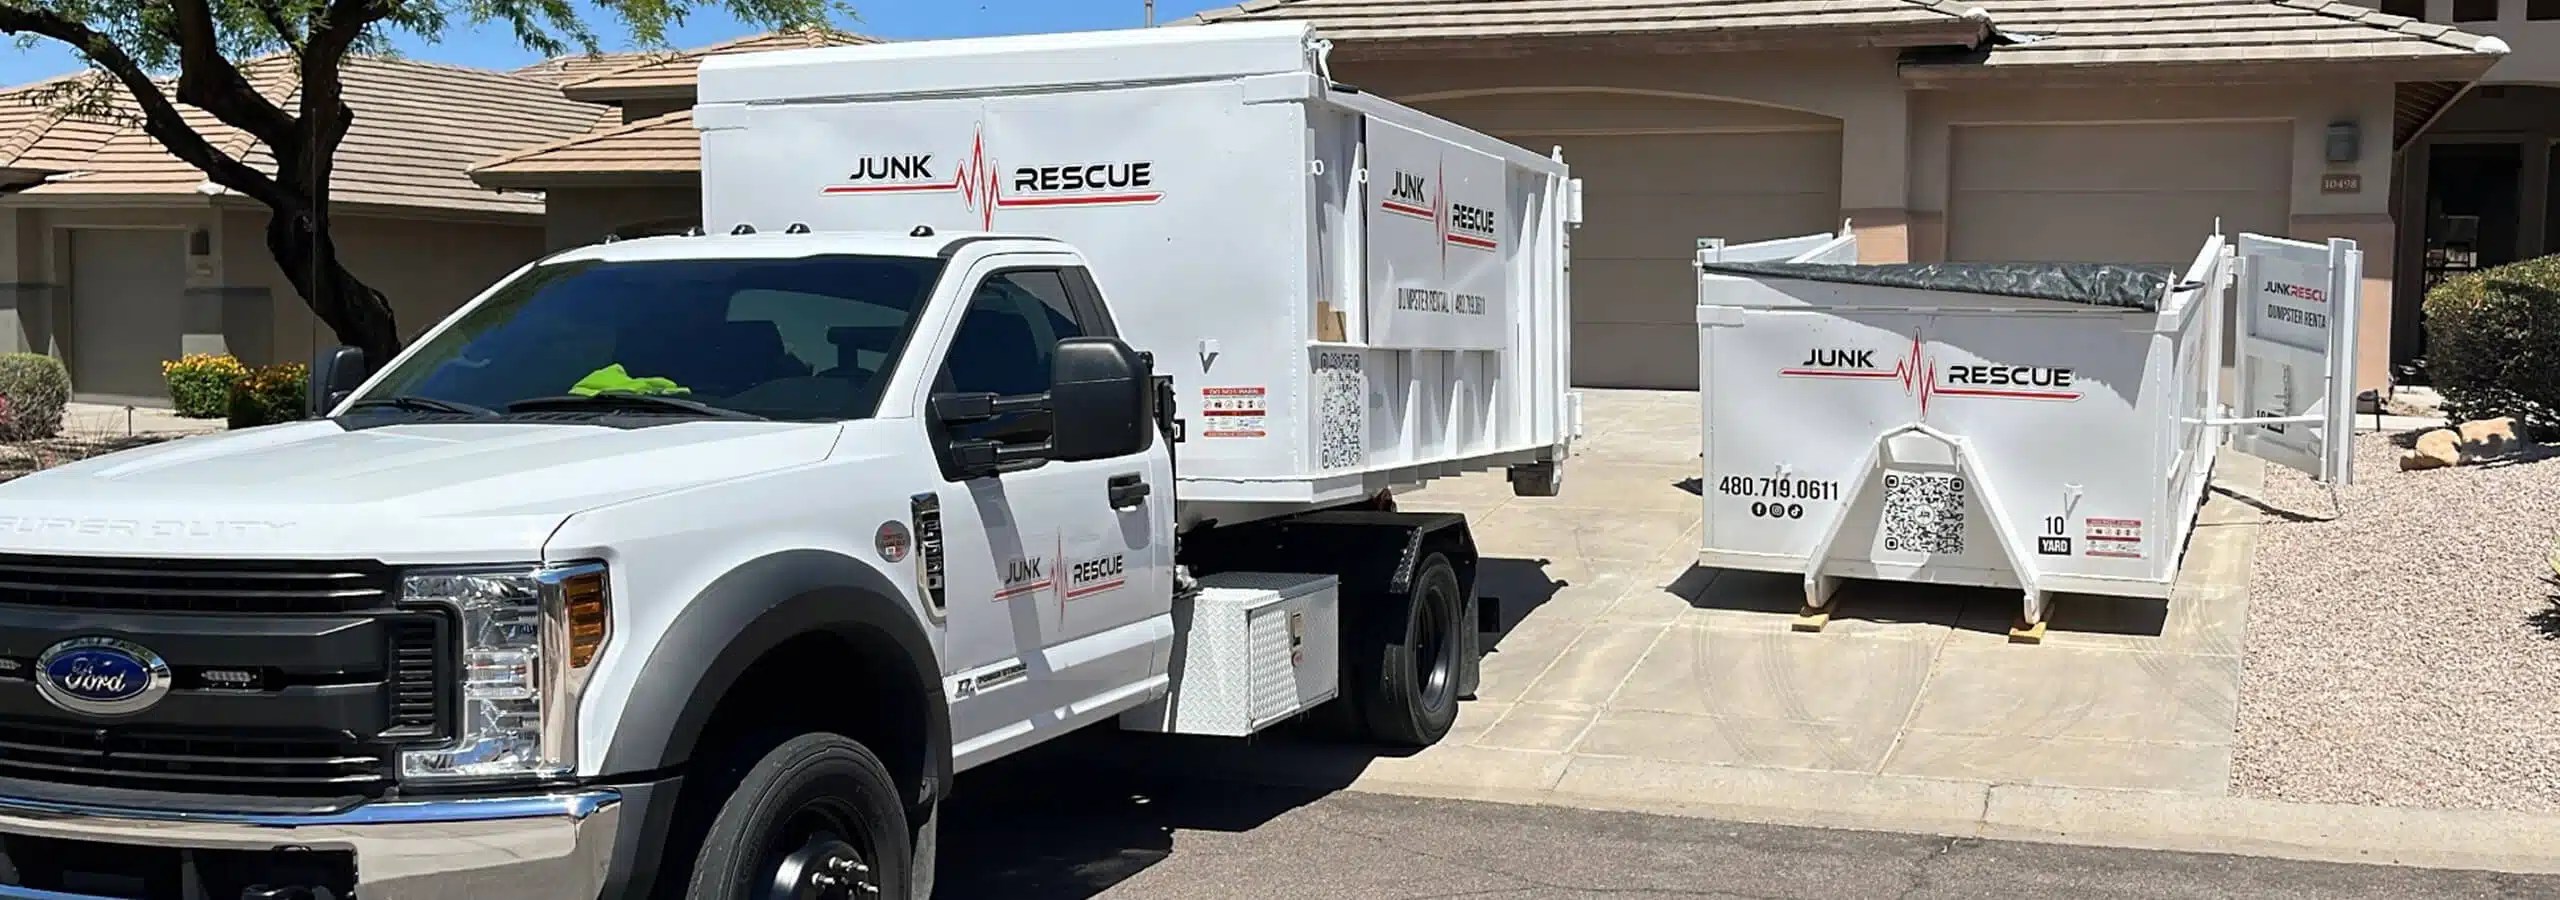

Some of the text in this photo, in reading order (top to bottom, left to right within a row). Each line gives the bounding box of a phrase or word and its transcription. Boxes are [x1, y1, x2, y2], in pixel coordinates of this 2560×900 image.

[850, 155, 1151, 191] JUNK RESCUE
[1392, 170, 1494, 233] JUNK RESCUE
[2264, 281, 2327, 302] JUNKRESCU
[2267, 304, 2327, 329] DUMPSTER RENTA
[1803, 348, 2073, 387] JUNK RESCUE
[1720, 476, 1838, 500] 480.719.0611
[2045, 516, 2064, 535] 10
[2042, 539, 2068, 552] YARD
[1005, 555, 1123, 584] JUNK RESCUE
[65, 657, 126, 692] Ford
